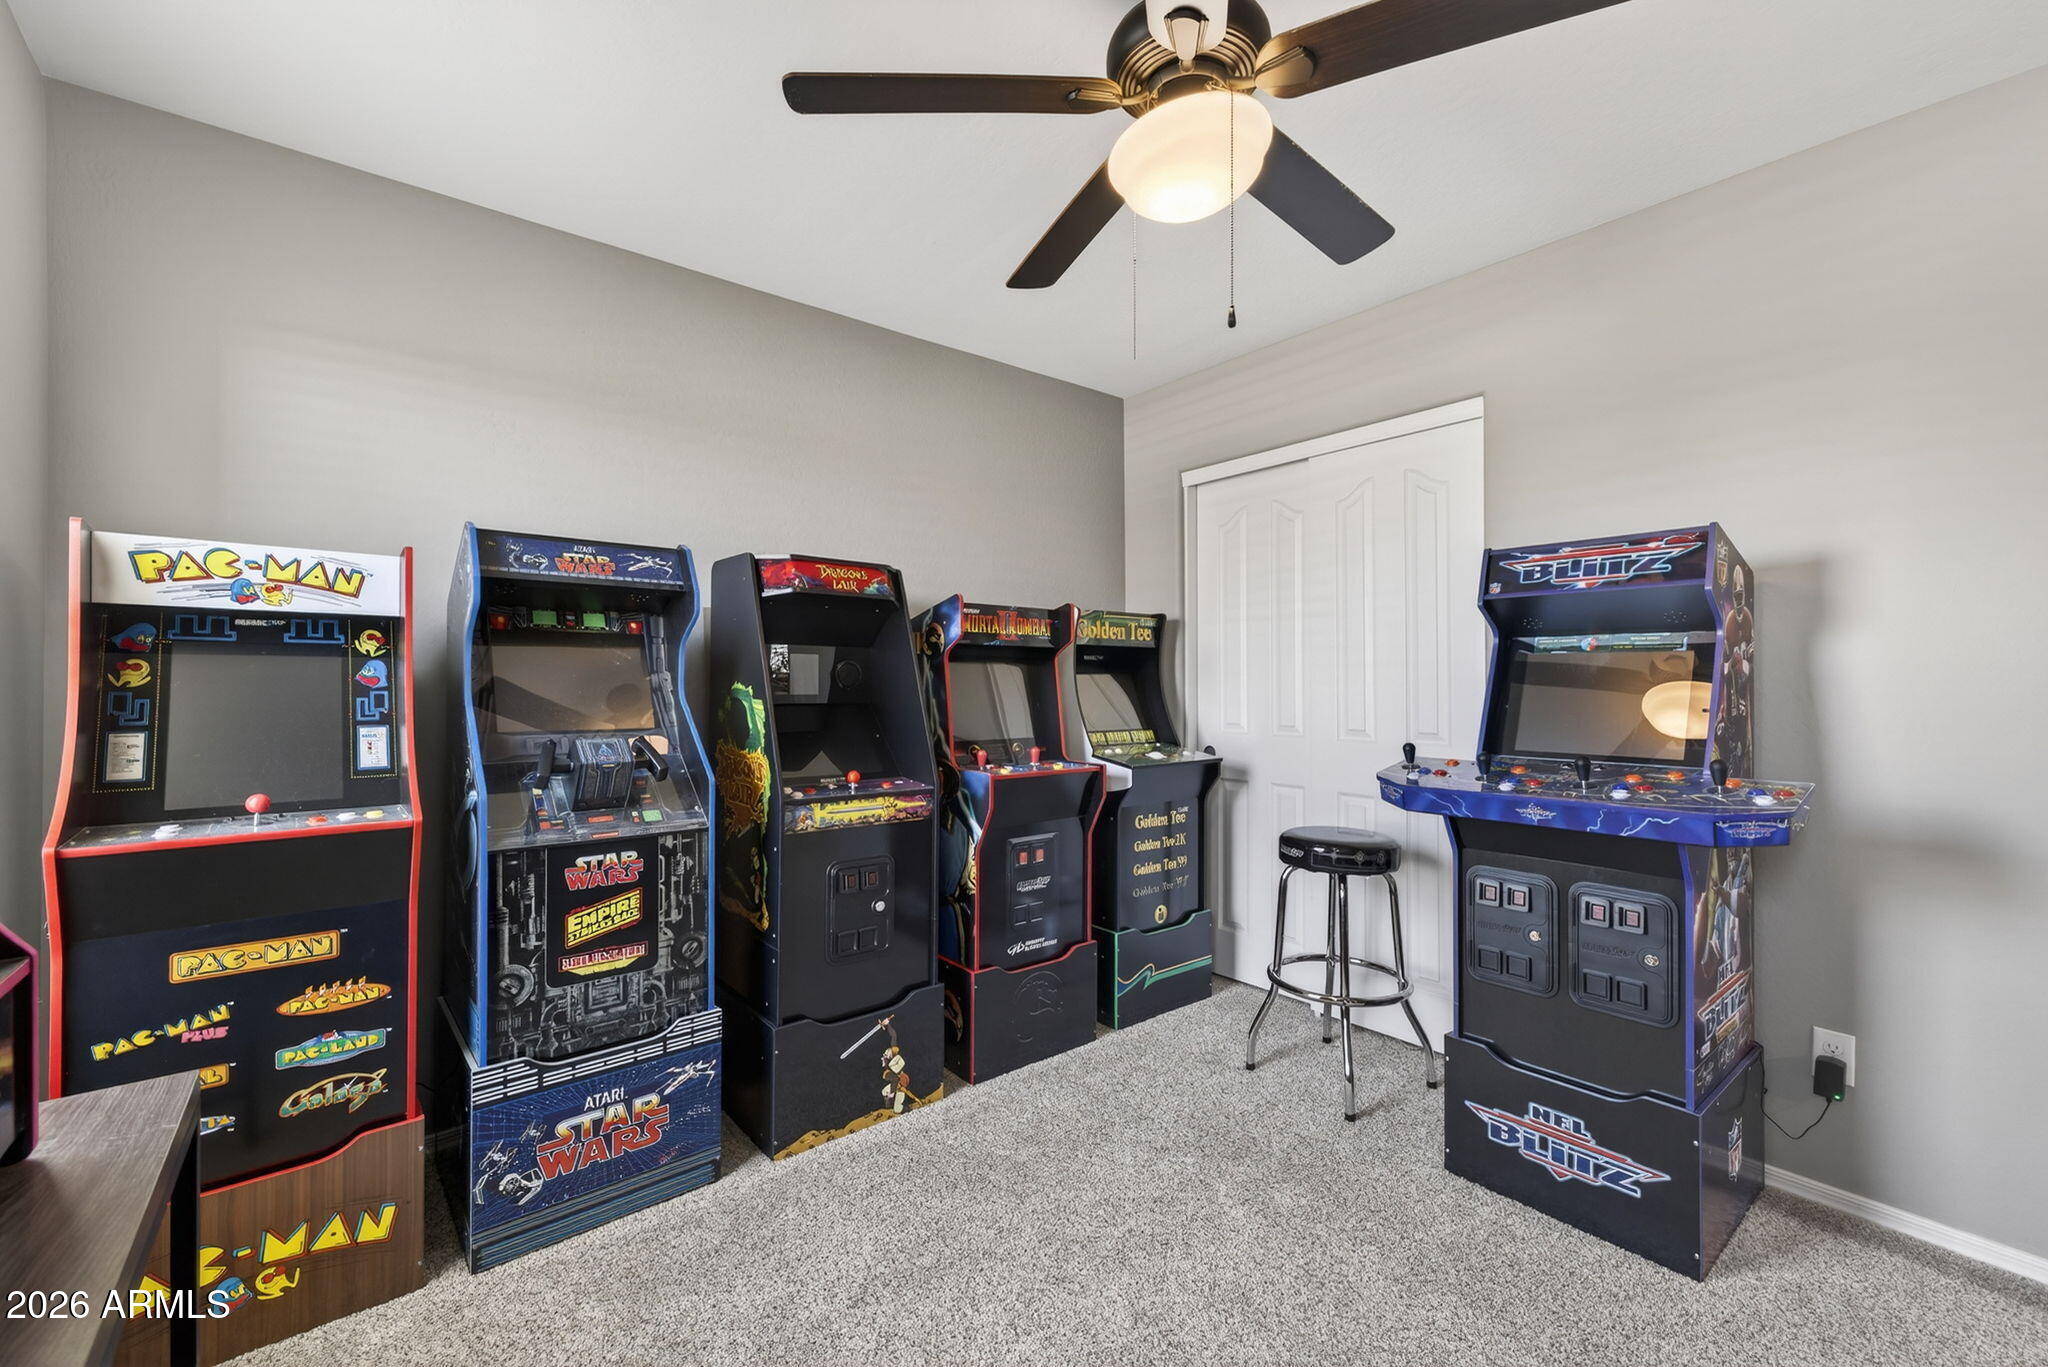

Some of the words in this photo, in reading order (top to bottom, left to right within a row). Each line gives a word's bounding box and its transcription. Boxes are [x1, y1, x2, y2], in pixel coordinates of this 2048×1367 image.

[127, 547, 369, 599] PAC-MAN
[1512, 548, 1688, 585] BLITZ
[1077, 618, 1126, 640] Golden
[1128, 622, 1153, 641] Tee
[1134, 813, 1169, 830] Golden
[1170, 810, 1187, 825] Tee
[564, 850, 643, 874] STAR
[564, 864, 644, 891] WARS
[567, 894, 640, 935] EMPIRE
[176, 934, 334, 978] PAC-MAN
[91, 1004, 231, 1061] PAC-MAN
[283, 1034, 379, 1064] PAC-LAND
[584, 1087, 627, 1111] ATARI
[537, 1092, 669, 1154] STAR
[1529, 1102, 1592, 1139] NFL
[537, 1115, 669, 1181] WARS
[1484, 1114, 1650, 1199] BLITZ
